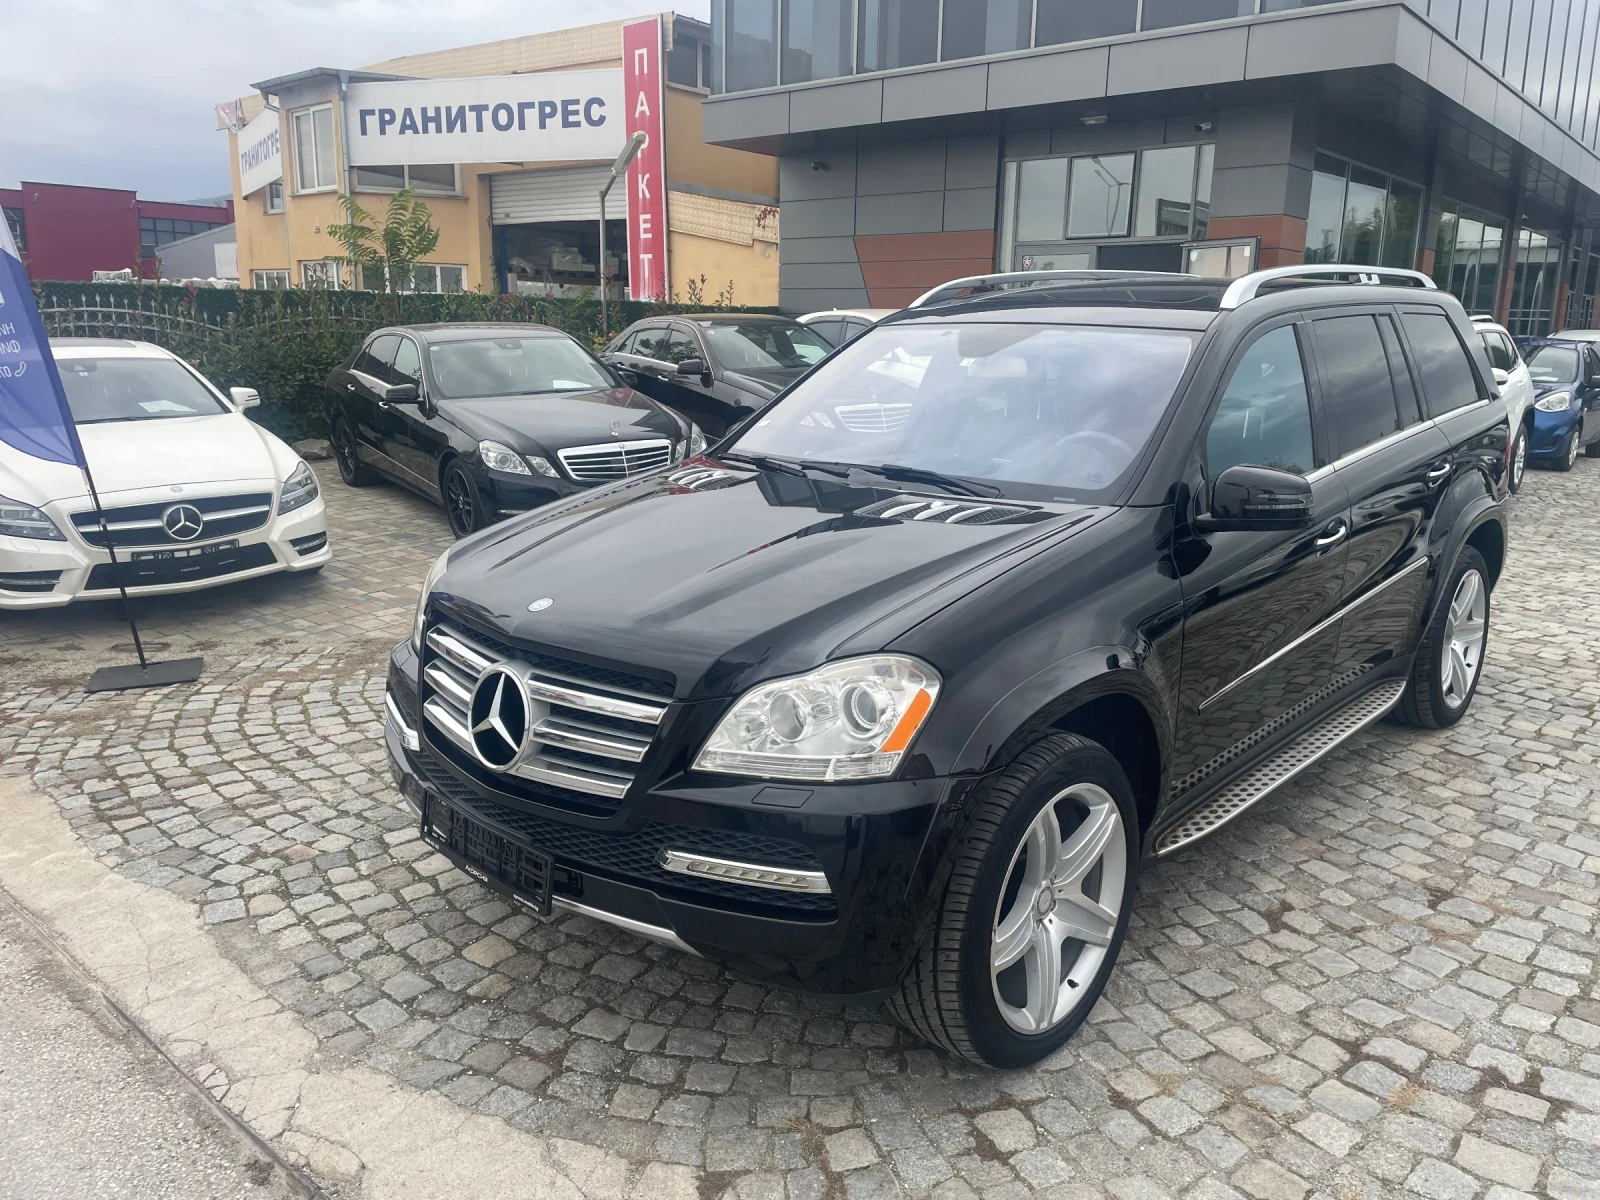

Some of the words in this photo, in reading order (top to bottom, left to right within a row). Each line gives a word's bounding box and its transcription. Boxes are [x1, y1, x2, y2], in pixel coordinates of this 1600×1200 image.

[359, 97, 606, 136] ГРАНИТОГРЕС
[241, 129, 280, 175] ГРАНИТОГРЕ
[634, 48, 653, 278] ПАРКЕТ
